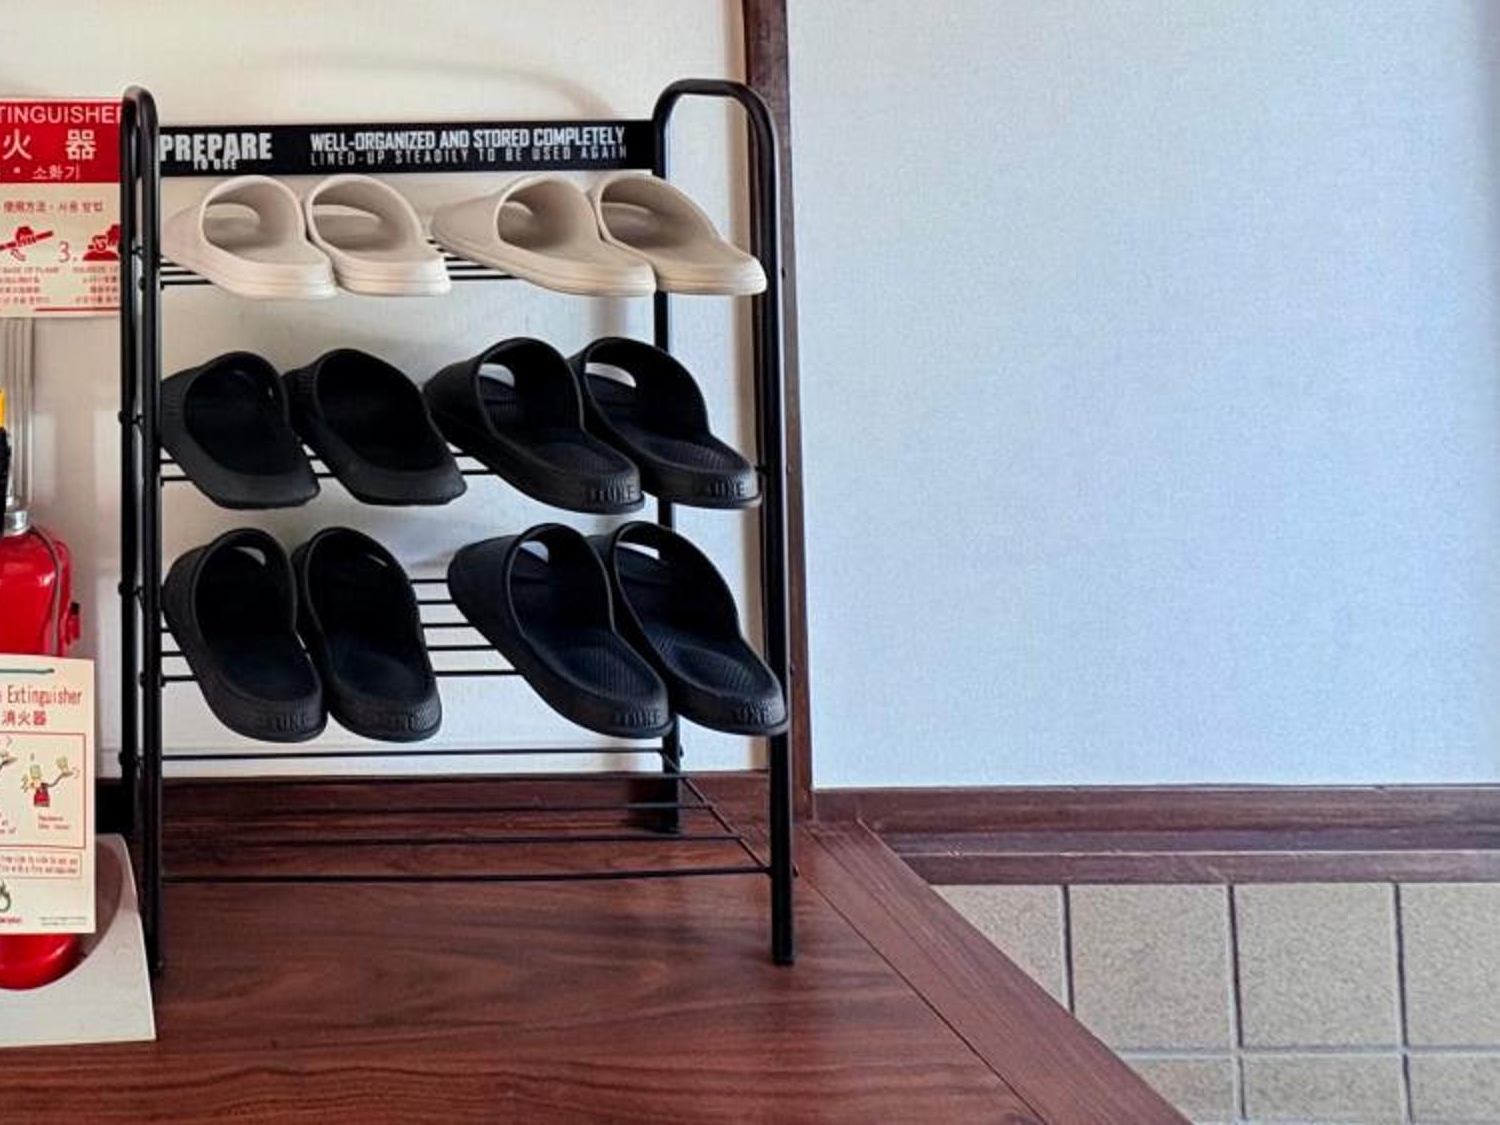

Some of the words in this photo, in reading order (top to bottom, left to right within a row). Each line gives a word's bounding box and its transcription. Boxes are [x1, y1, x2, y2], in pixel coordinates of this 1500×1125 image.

[159, 132, 273, 162] PREPARE
[310, 131, 436, 152] WELL-ORGANIZED
[439, 129, 470, 149] AND
[473, 128, 530, 148] STORED
[533, 126, 625, 146] COMPLETELY
[193, 158, 208, 171] TO
[213, 158, 237, 170] USE
[311, 150, 385, 166] LINED-UP
[396, 148, 469, 164] STEADILY
[479, 147, 496, 162] TO
[506, 146, 522, 161] BE
[532, 146, 571, 161] USED
[580, 145, 627, 159] AGAIN
[7, 683, 83, 707] Extinguisher
